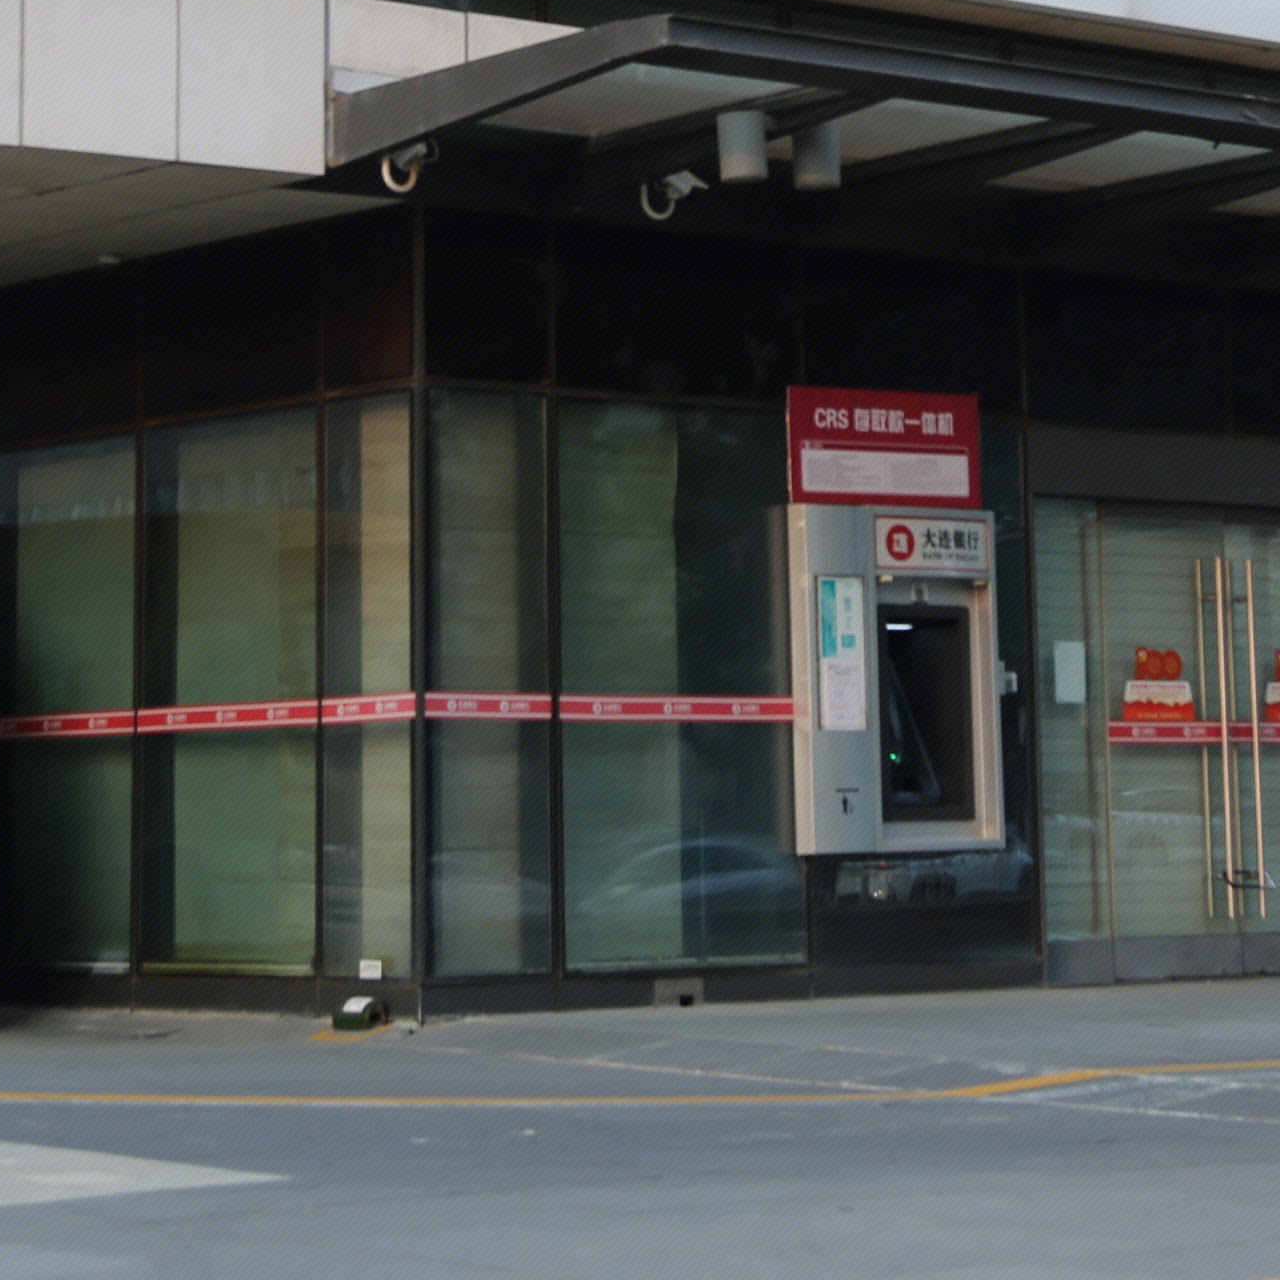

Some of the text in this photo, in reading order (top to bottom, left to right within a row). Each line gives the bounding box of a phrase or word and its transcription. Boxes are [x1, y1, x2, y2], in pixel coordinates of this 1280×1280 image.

[814, 407, 849, 429] CRS
[921, 527, 979, 550] 大连银行
